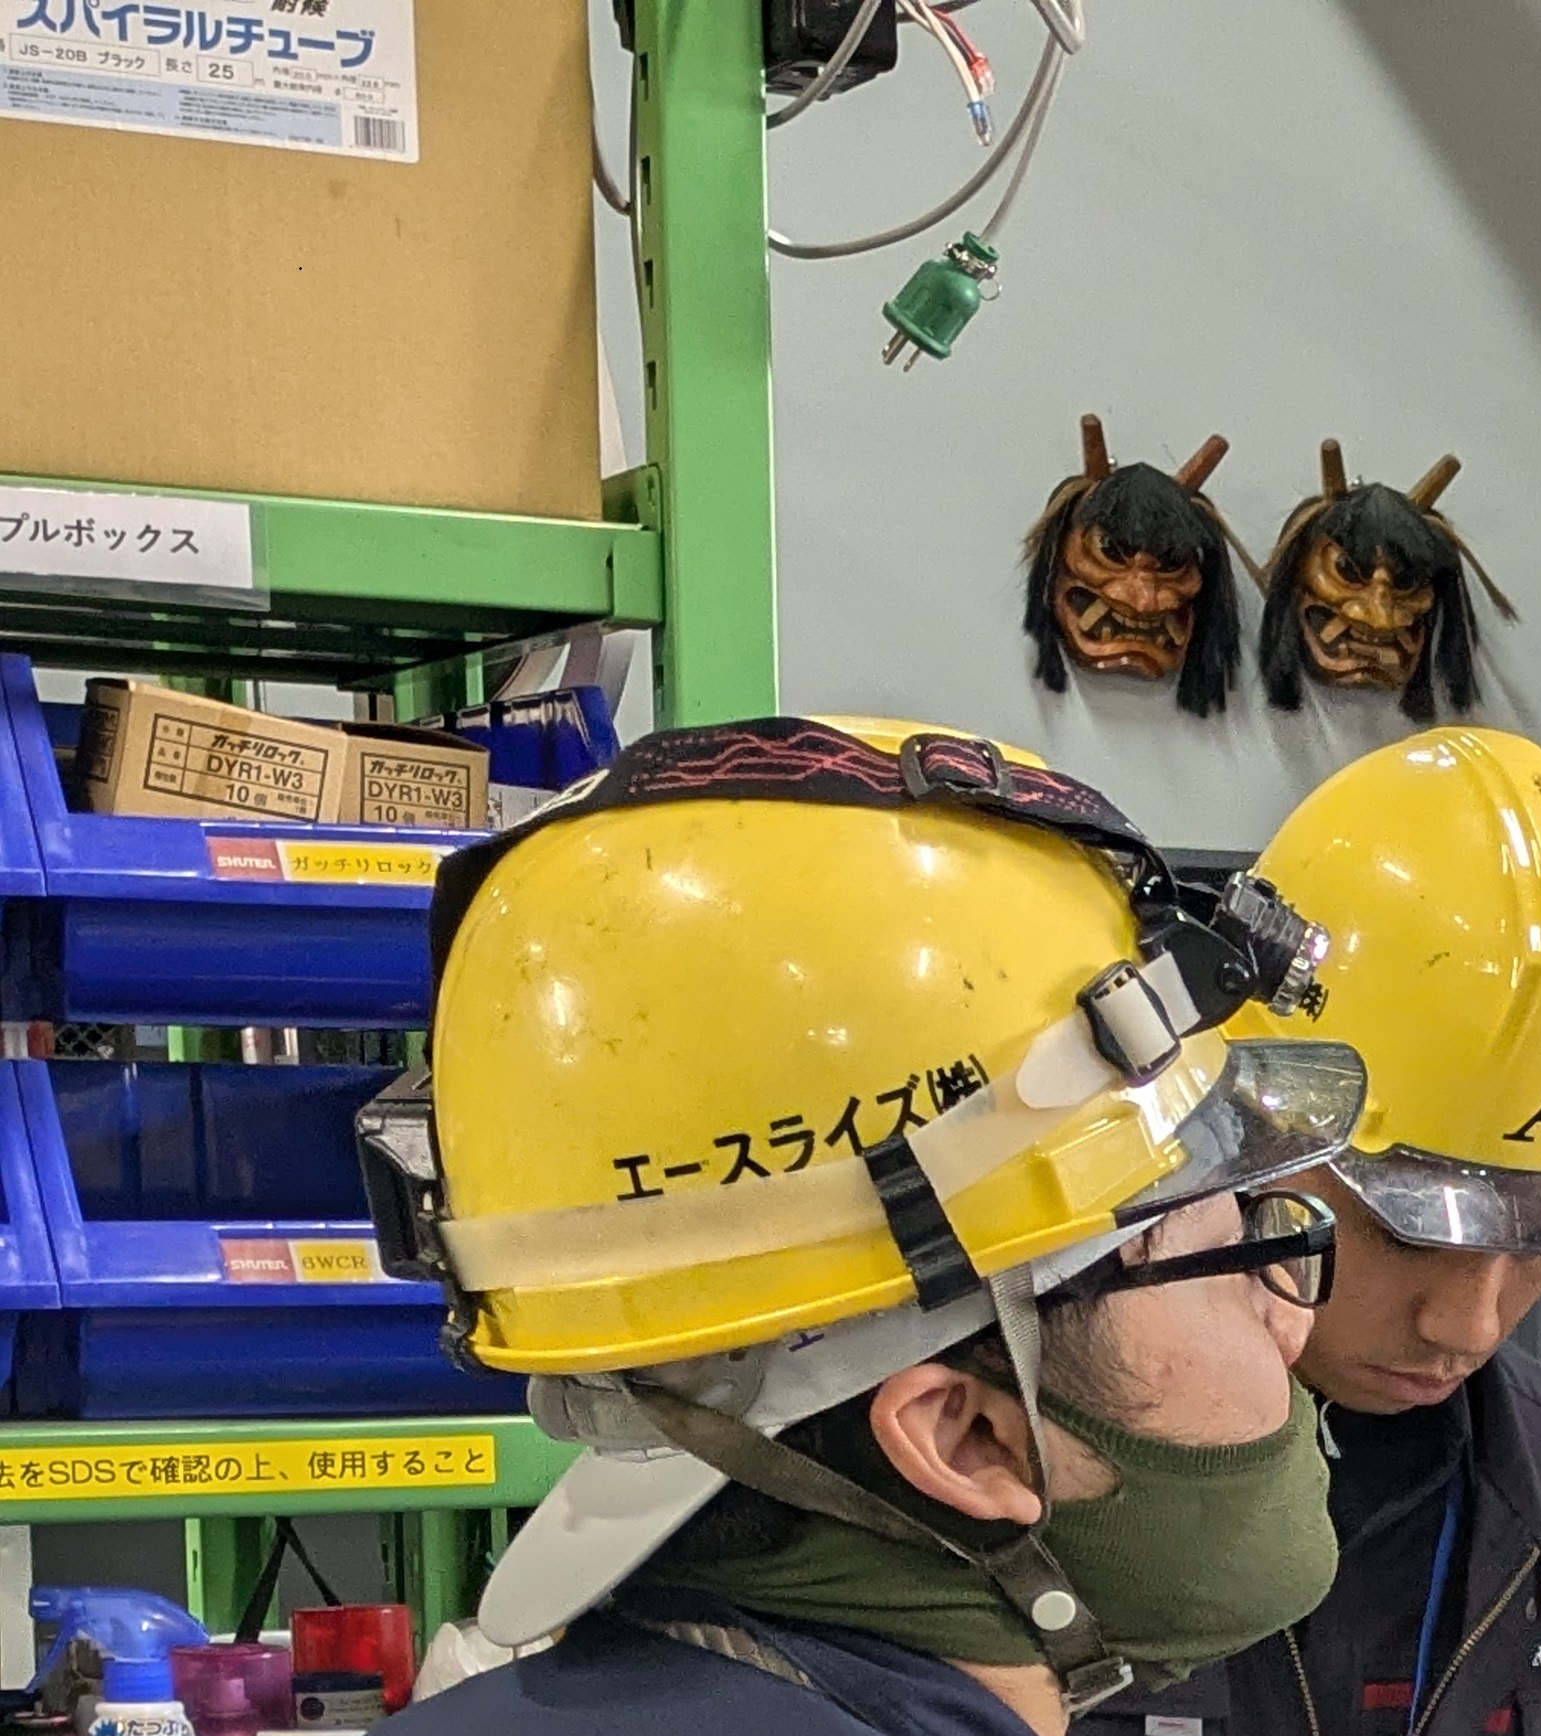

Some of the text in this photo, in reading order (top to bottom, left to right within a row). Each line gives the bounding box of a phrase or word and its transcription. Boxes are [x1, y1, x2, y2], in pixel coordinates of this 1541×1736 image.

[17, 0, 375, 67] スパイラルチューブ
[19, 44, 87, 63] JS-20B
[97, 51, 146, 70] ブラック
[165, 57, 193, 73] 長さ
[208, 63, 235, 80] 25
[0, 512, 200, 554] プルボックス
[207, 754, 304, 790] DYR1-W3
[226, 783, 249, 803] 10
[368, 780, 463, 808] DYR1-W3
[374, 804, 397, 823] 10
[292, 855, 432, 875] ガッチリロック
